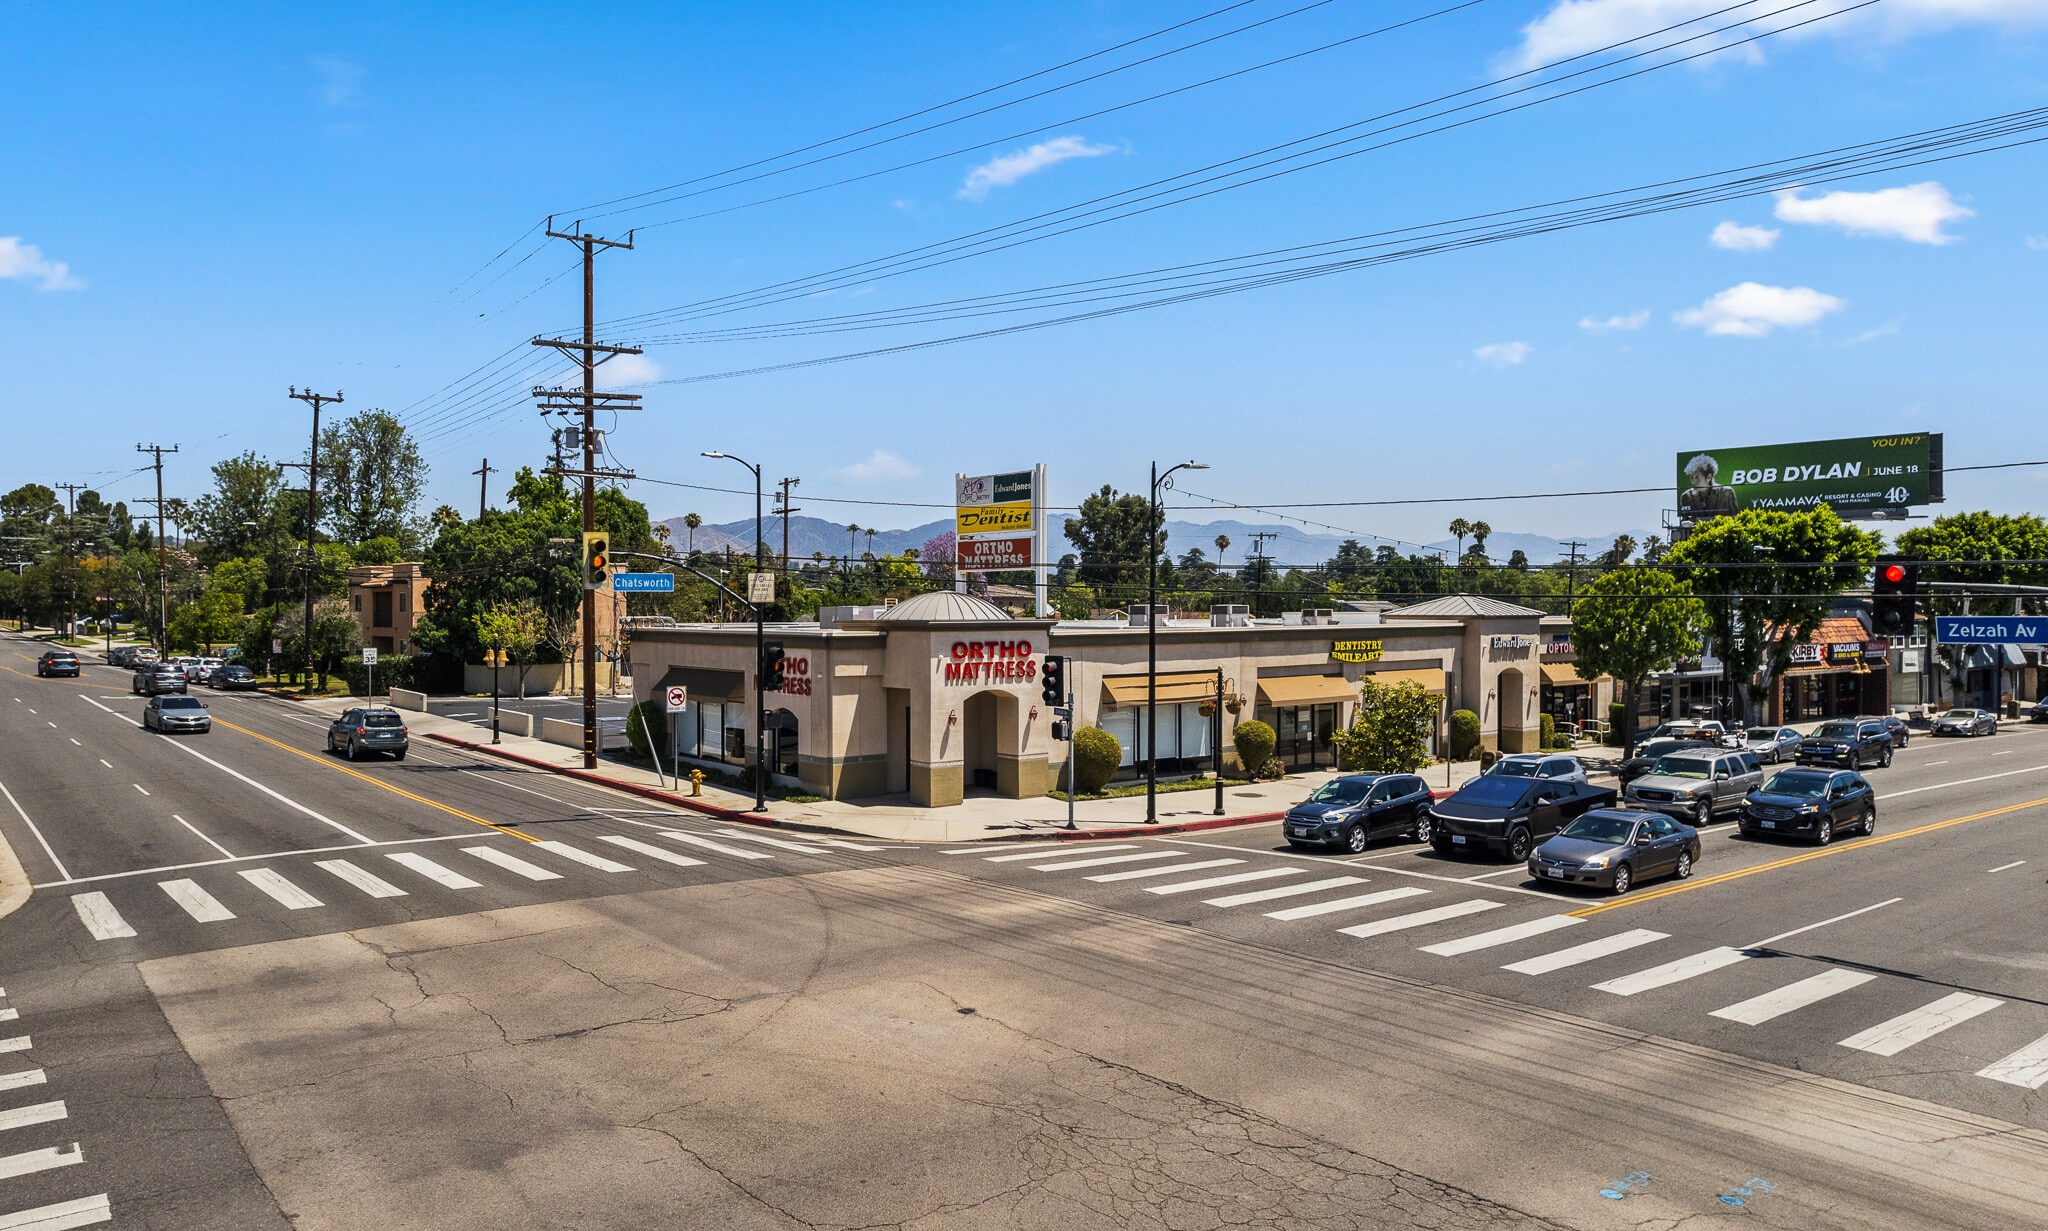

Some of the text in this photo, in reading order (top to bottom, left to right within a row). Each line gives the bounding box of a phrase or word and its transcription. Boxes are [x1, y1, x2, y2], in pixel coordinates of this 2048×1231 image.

[1872, 438, 1897, 447] YOU
[1900, 436, 1920, 446] IN?
[1731, 461, 1919, 485] BOB DYLAN JUNE 18
[1884, 486, 1908, 503] 40
[959, 509, 1031, 527] Dentist
[980, 507, 1005, 516] Family
[974, 541, 1014, 555] ORTHO
[964, 553, 1024, 568] MATTRESS
[614, 578, 670, 588] Chatsworth
[1948, 623, 2037, 637] Zelzah Av
[951, 640, 1032, 660] ORTHO
[1334, 640, 1383, 651] DENTISTRY
[1792, 645, 1817, 657] KIRBY
[1833, 643, 1860, 653] VACUUMS
[1331, 649, 1385, 662] SMILEARTS
[945, 660, 1037, 681] MATTRESS
